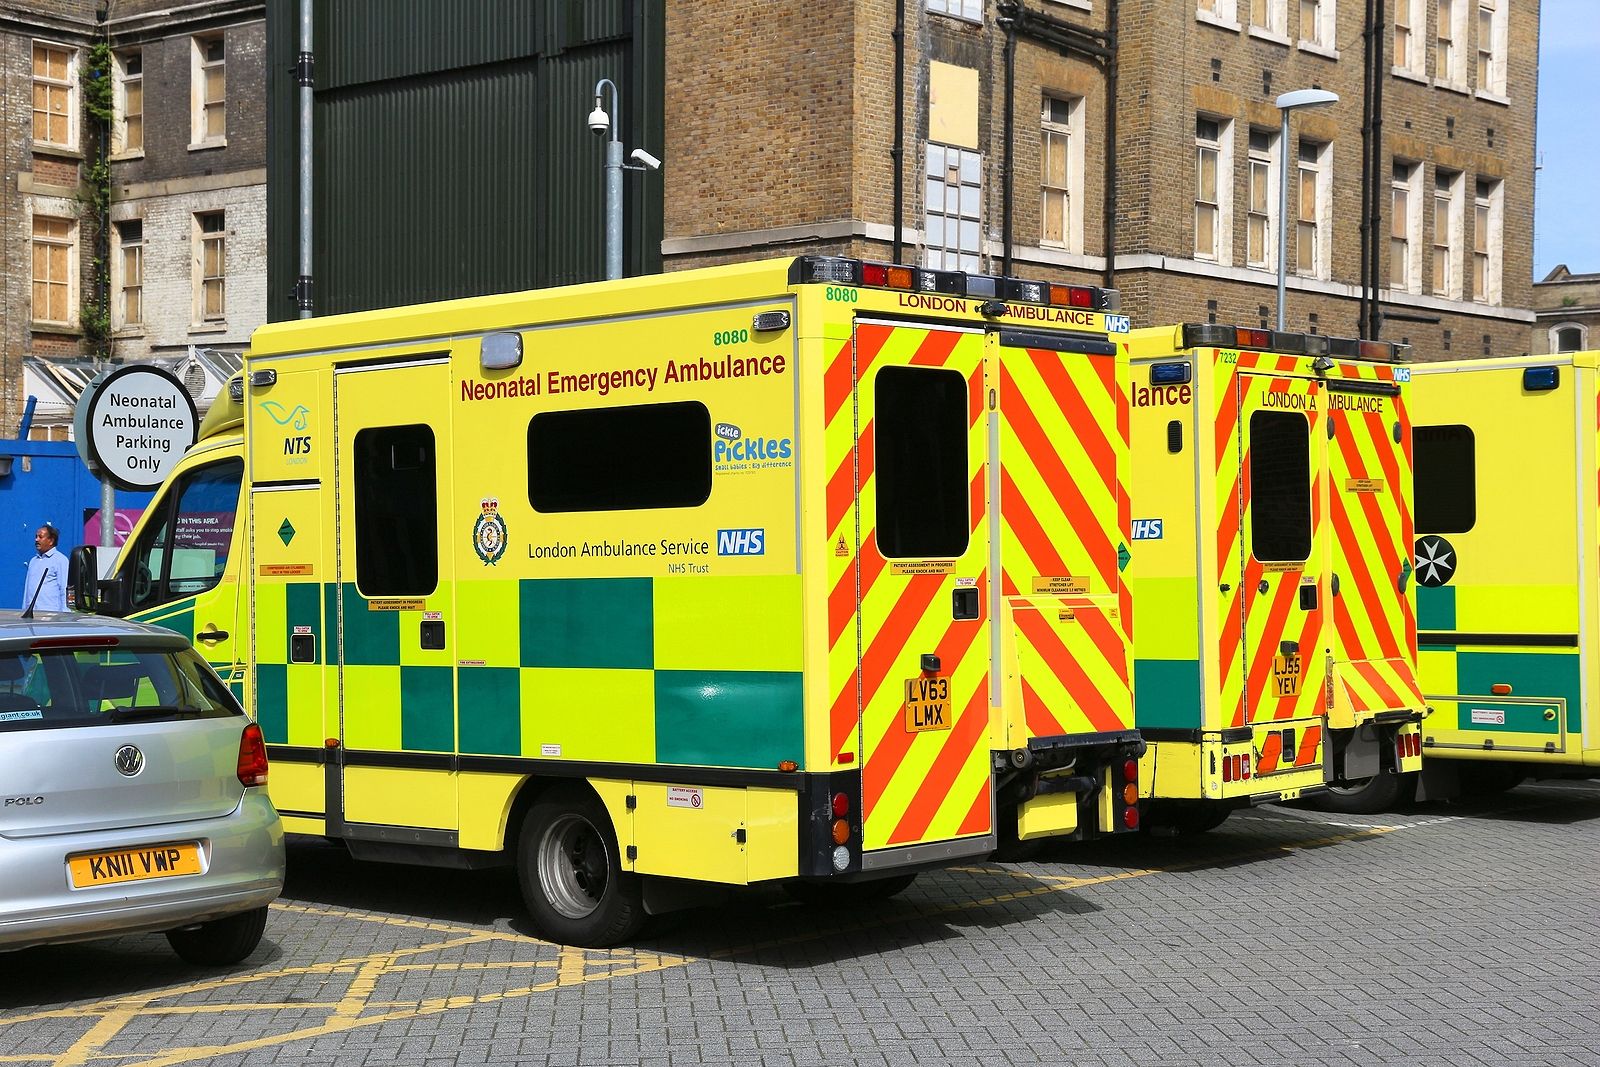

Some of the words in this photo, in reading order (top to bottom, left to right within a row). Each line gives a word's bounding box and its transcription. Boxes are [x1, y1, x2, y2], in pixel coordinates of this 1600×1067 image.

[826, 286, 858, 303] 8080
[898, 293, 967, 314] LONDON
[1003, 304, 1095, 326] AMBULANCE
[1104, 316, 1129, 332] NHS
[714, 328, 748, 346] 8080
[1220, 352, 1237, 364] 7232
[461, 373, 541, 402] Neonatal
[548, 367, 658, 396] Emergency
[664, 354, 786, 384] Ambulance
[1394, 368, 1410, 382] NHS
[110, 393, 176, 408] Neonatal
[1132, 382, 1192, 408] lance
[1262, 390, 1306, 410] LONDON
[102, 414, 184, 430] Ambulance
[717, 424, 739, 438] ickle
[116, 434, 171, 453] Parking
[284, 436, 312, 456] NTS
[126, 456, 161, 473] Only
[762, 461, 792, 469] difference
[528, 542, 576, 558] London
[580, 540, 656, 557] Ambulance
[660, 538, 710, 556] Service
[718, 530, 763, 554] NHS
[668, 563, 686, 574] NHS
[688, 563, 710, 574] Trust
[1274, 658, 1300, 676] LJ55
[909, 678, 948, 702] LV63
[1276, 676, 1296, 694] YEV
[0, 710, 41, 720] giant.co.uk
[914, 704, 944, 726] LMX
[4, 796, 44, 807] POLO
[89, 853, 134, 880] KN11
[138, 848, 181, 874] VWP
